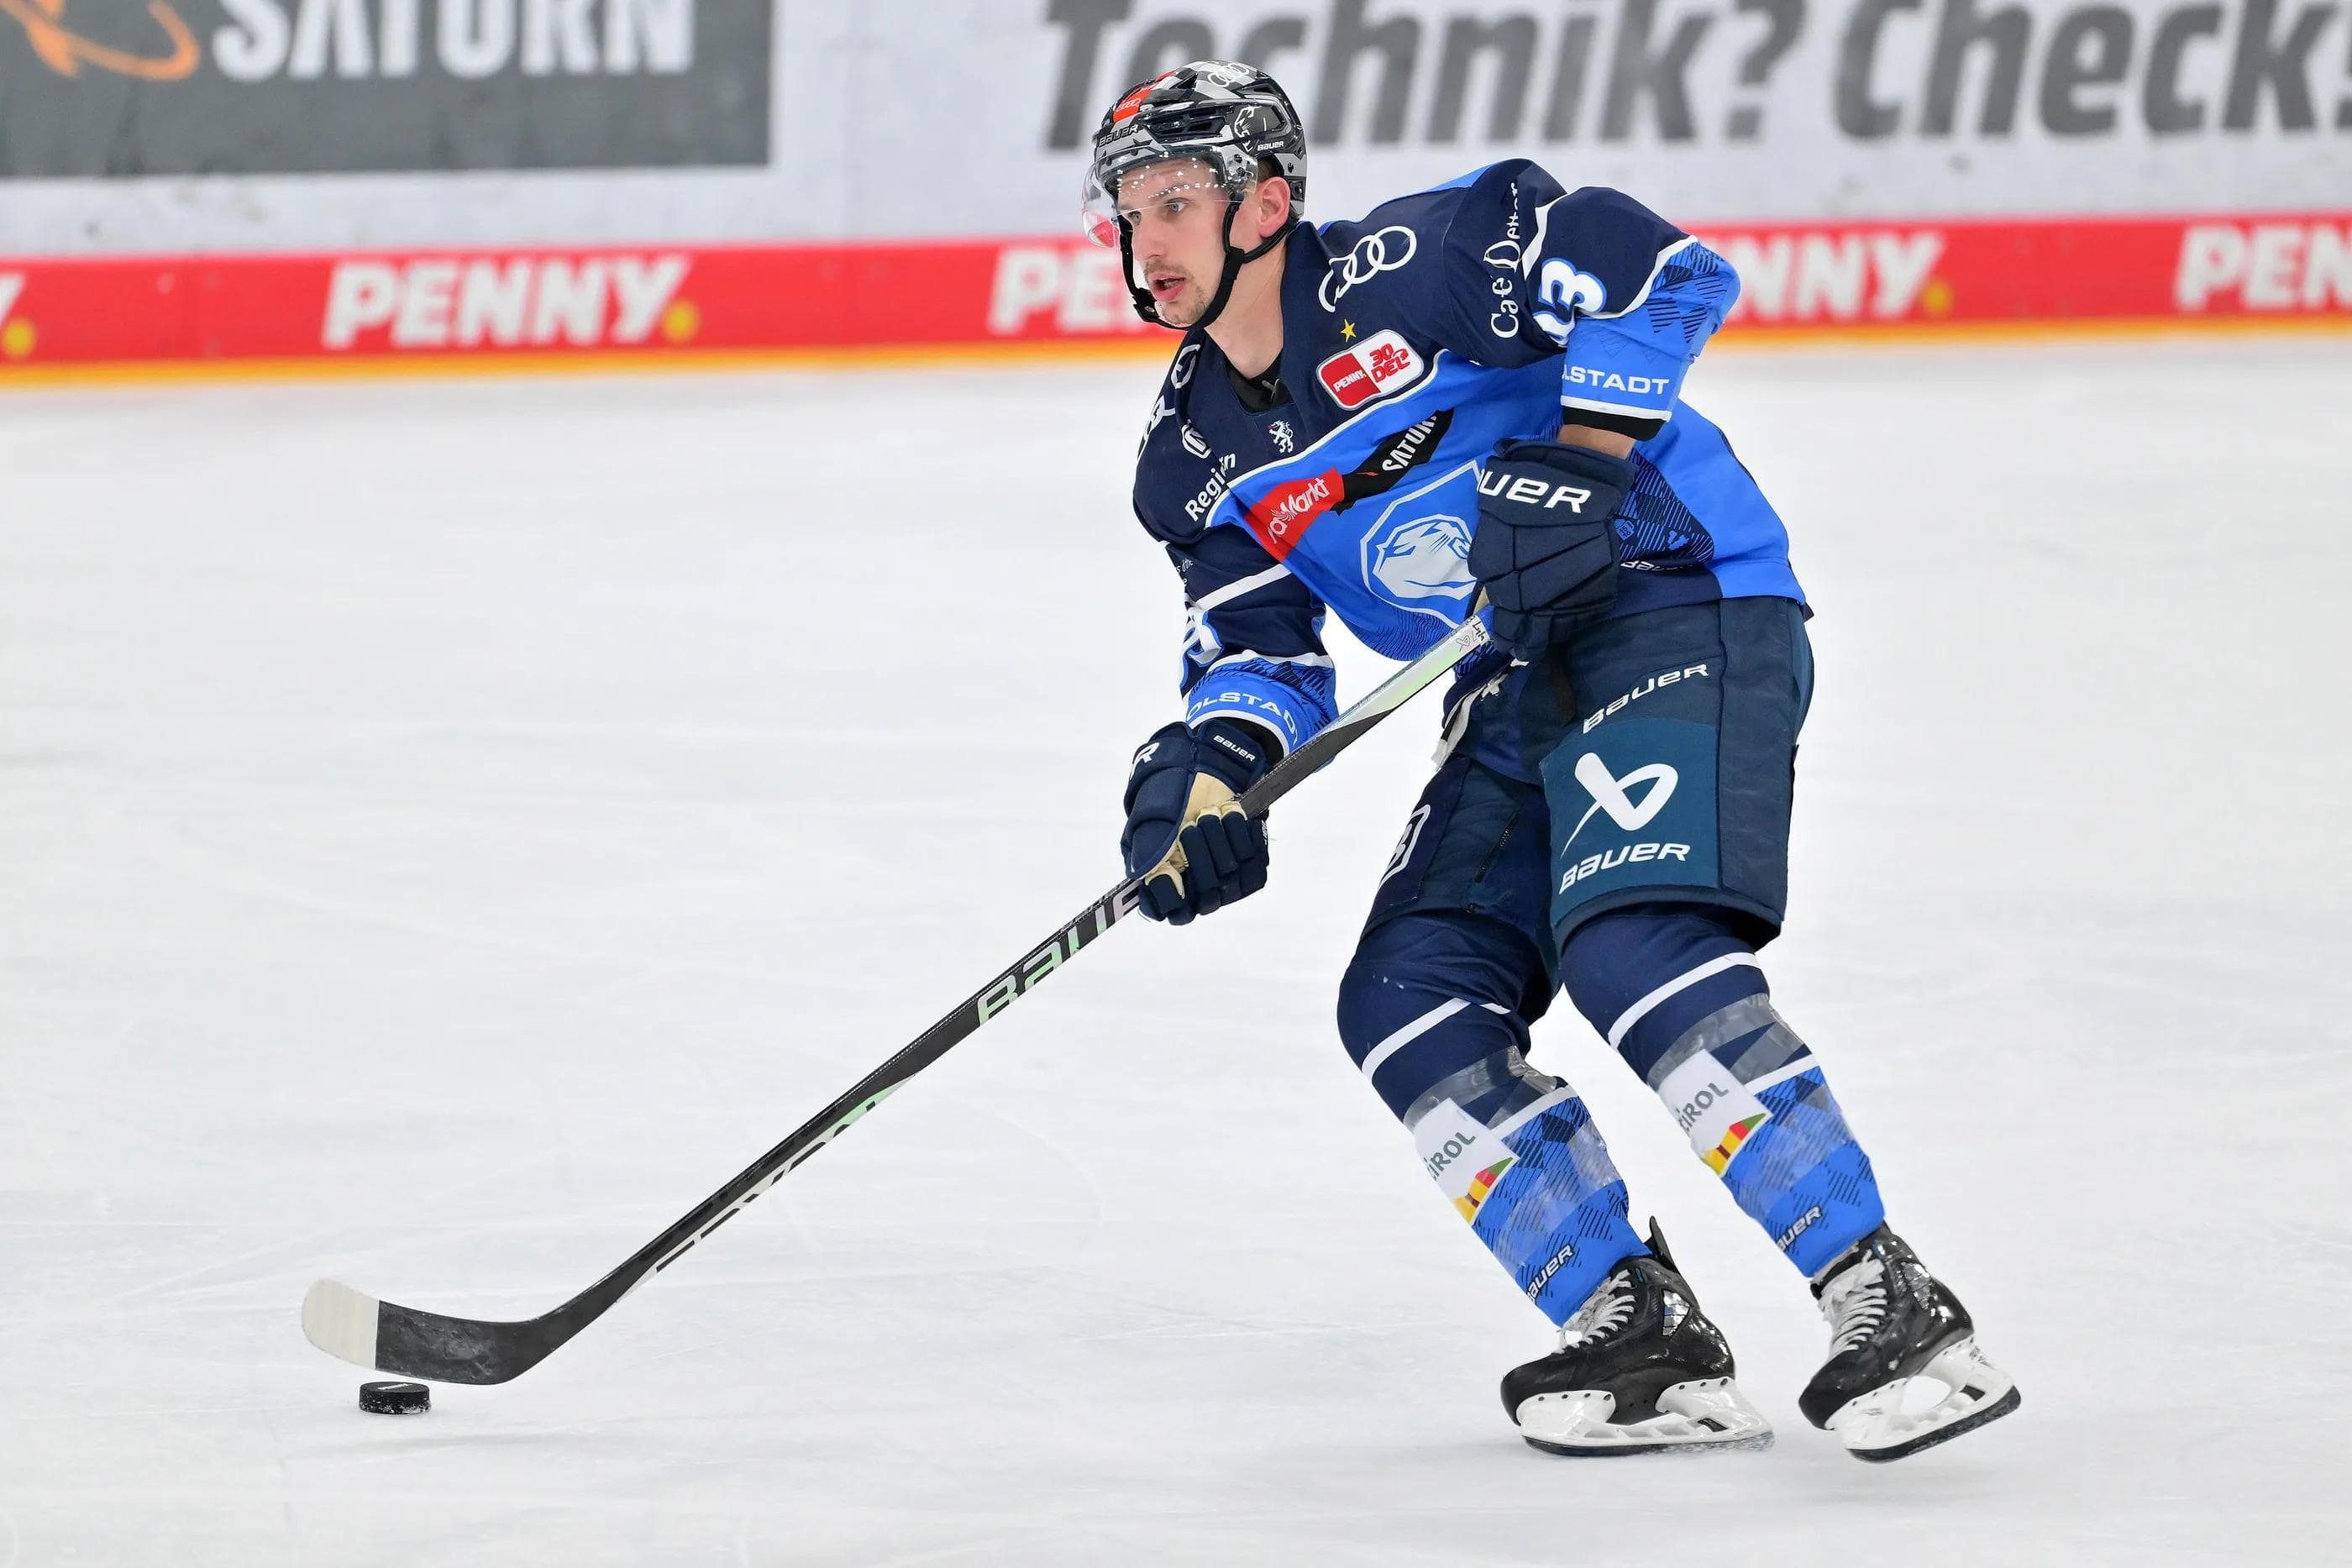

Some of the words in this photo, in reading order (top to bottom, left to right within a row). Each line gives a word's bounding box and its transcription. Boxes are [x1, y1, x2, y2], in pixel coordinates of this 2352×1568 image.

[1099, 123, 1139, 147] BAUER
[1257, 140, 1284, 151] BAUER
[1369, 343, 1394, 368] 30
[1370, 348, 1411, 383] DEL
[1562, 364, 1670, 395] LSTADT
[1476, 469, 1592, 514] UER
[1583, 663, 1709, 734] BAUER
[1213, 735, 1256, 763] BAUER
[1558, 842, 1691, 895] BAUER
